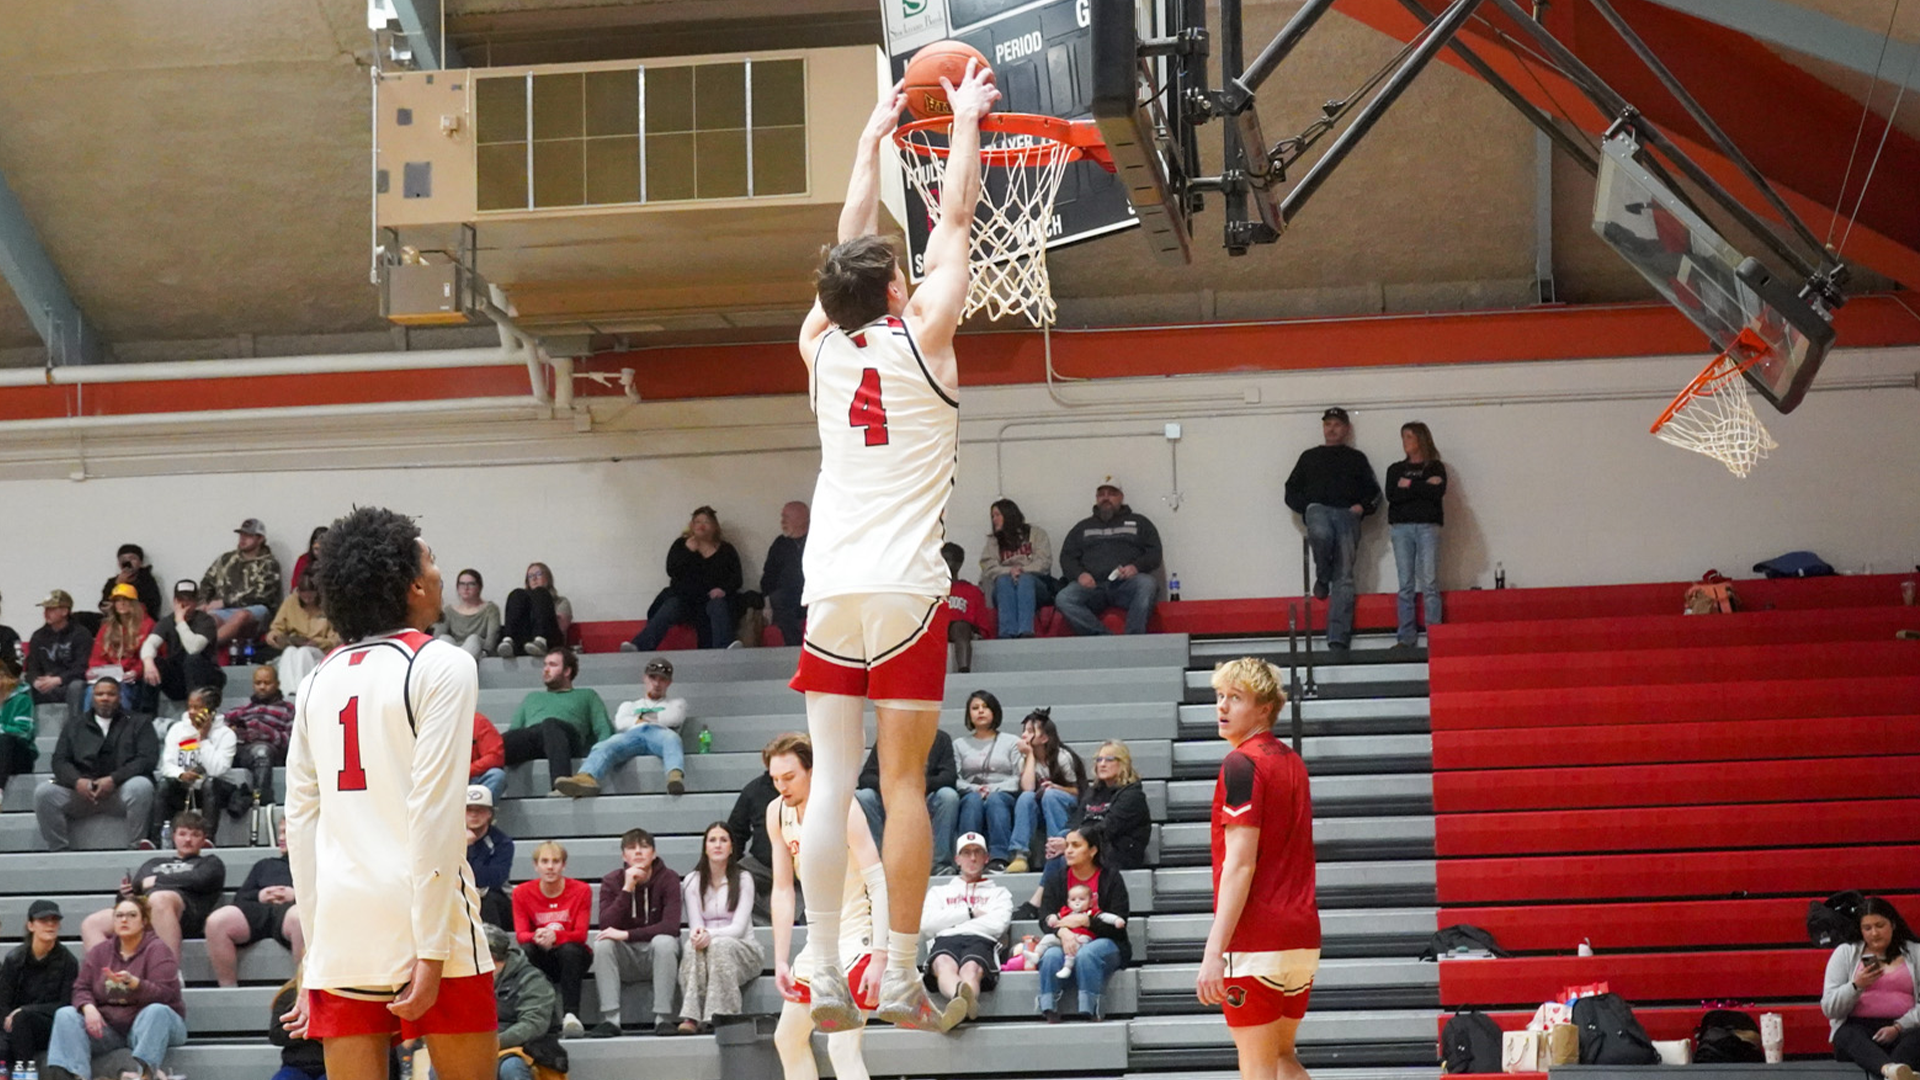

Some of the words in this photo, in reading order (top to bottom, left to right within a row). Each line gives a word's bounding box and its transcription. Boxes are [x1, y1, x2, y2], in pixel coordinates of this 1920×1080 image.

[995, 31, 1042, 64] PERIOD
[1015, 214, 1062, 246] MACH
[849, 367, 889, 447] 4
[178, 751, 201, 767] BLA
[337, 695, 367, 791] 1
